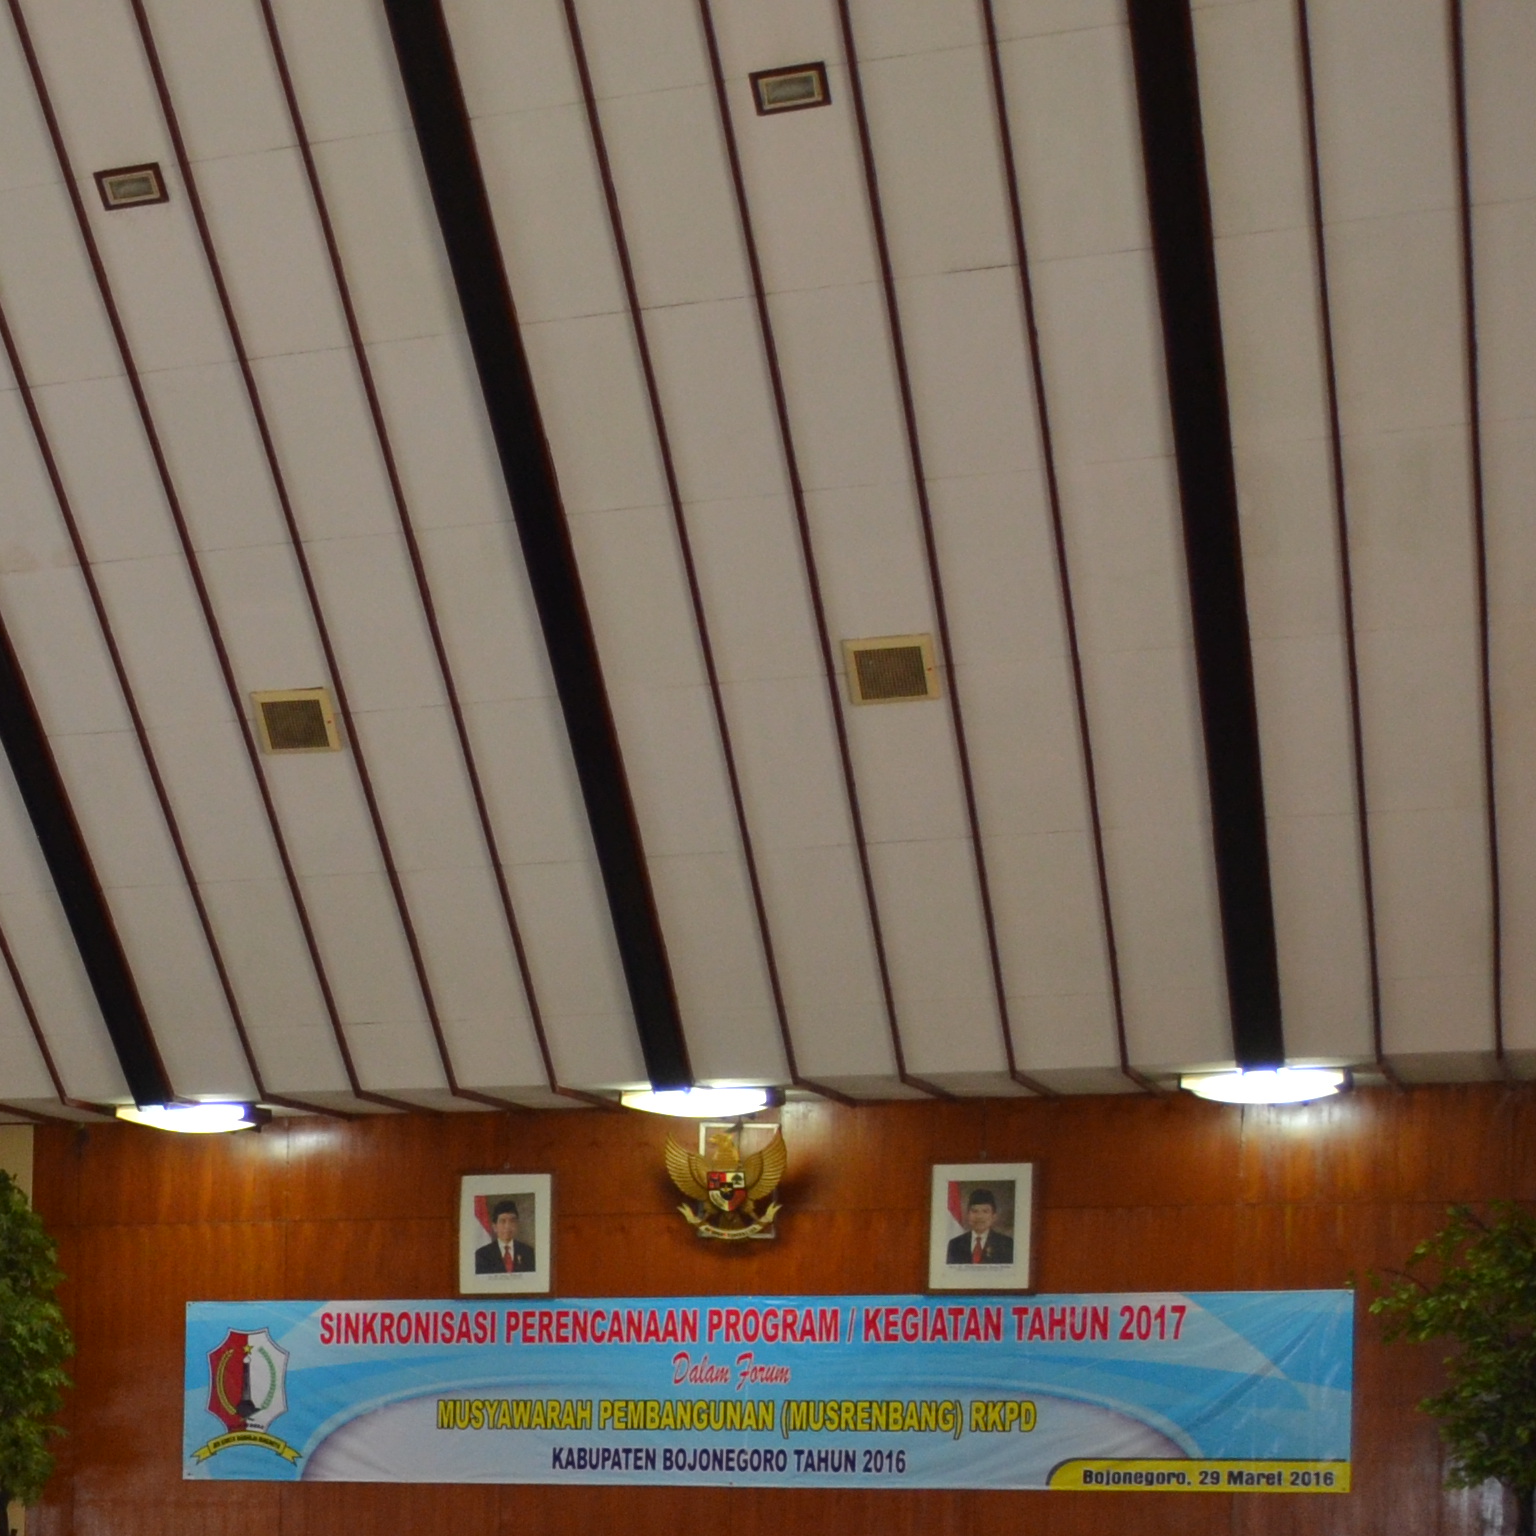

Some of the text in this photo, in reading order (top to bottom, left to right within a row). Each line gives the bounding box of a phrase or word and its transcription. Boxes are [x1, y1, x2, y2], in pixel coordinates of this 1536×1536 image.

[319, 1304, 1187, 1345] SINKRONISASI PERENCANAAN PROGRAM / KEGIATAN TAHUN 2017
[672, 1351, 791, 1392] Dalam Forum
[437, 1399, 1037, 1440] MUSYAWARAH PEMBANGUNAN (MUSRENBANG) RKPD
[551, 1447, 907, 1475] KABUPATEN BOJONEGORO TAHUN 2016
[1198, 1470, 1220, 1485] 29
[1227, 1471, 1282, 1486] Maret
[1290, 1471, 1334, 1486] 2016
